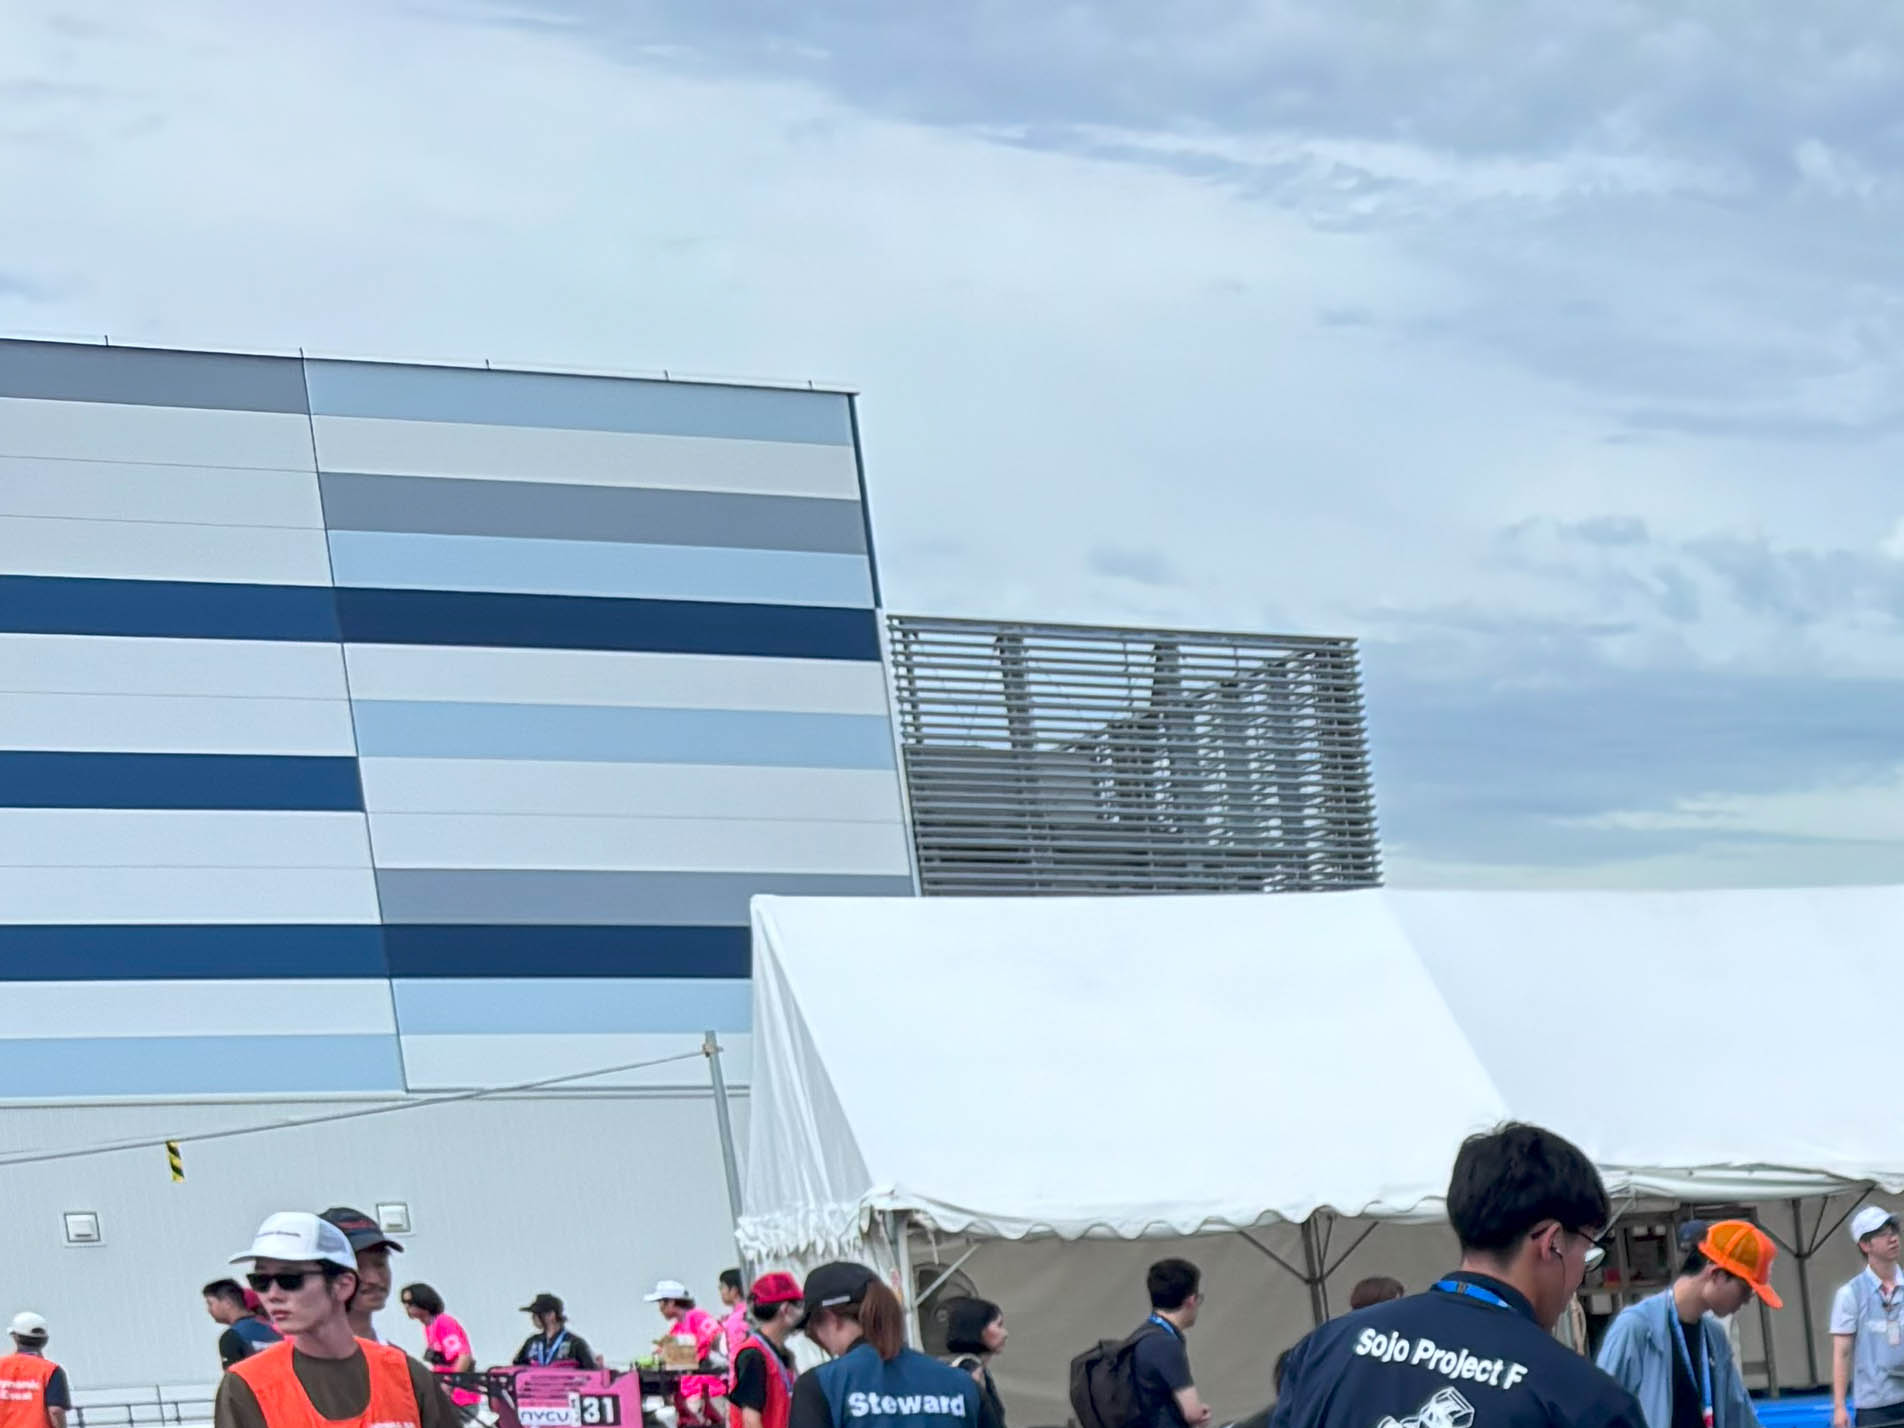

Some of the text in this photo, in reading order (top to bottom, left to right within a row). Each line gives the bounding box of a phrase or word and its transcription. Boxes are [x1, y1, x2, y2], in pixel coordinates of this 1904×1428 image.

[1356, 1327, 1528, 1390] Sojo Project F
[582, 1396, 616, 1425] 31
[847, 1390, 968, 1420] Steward
